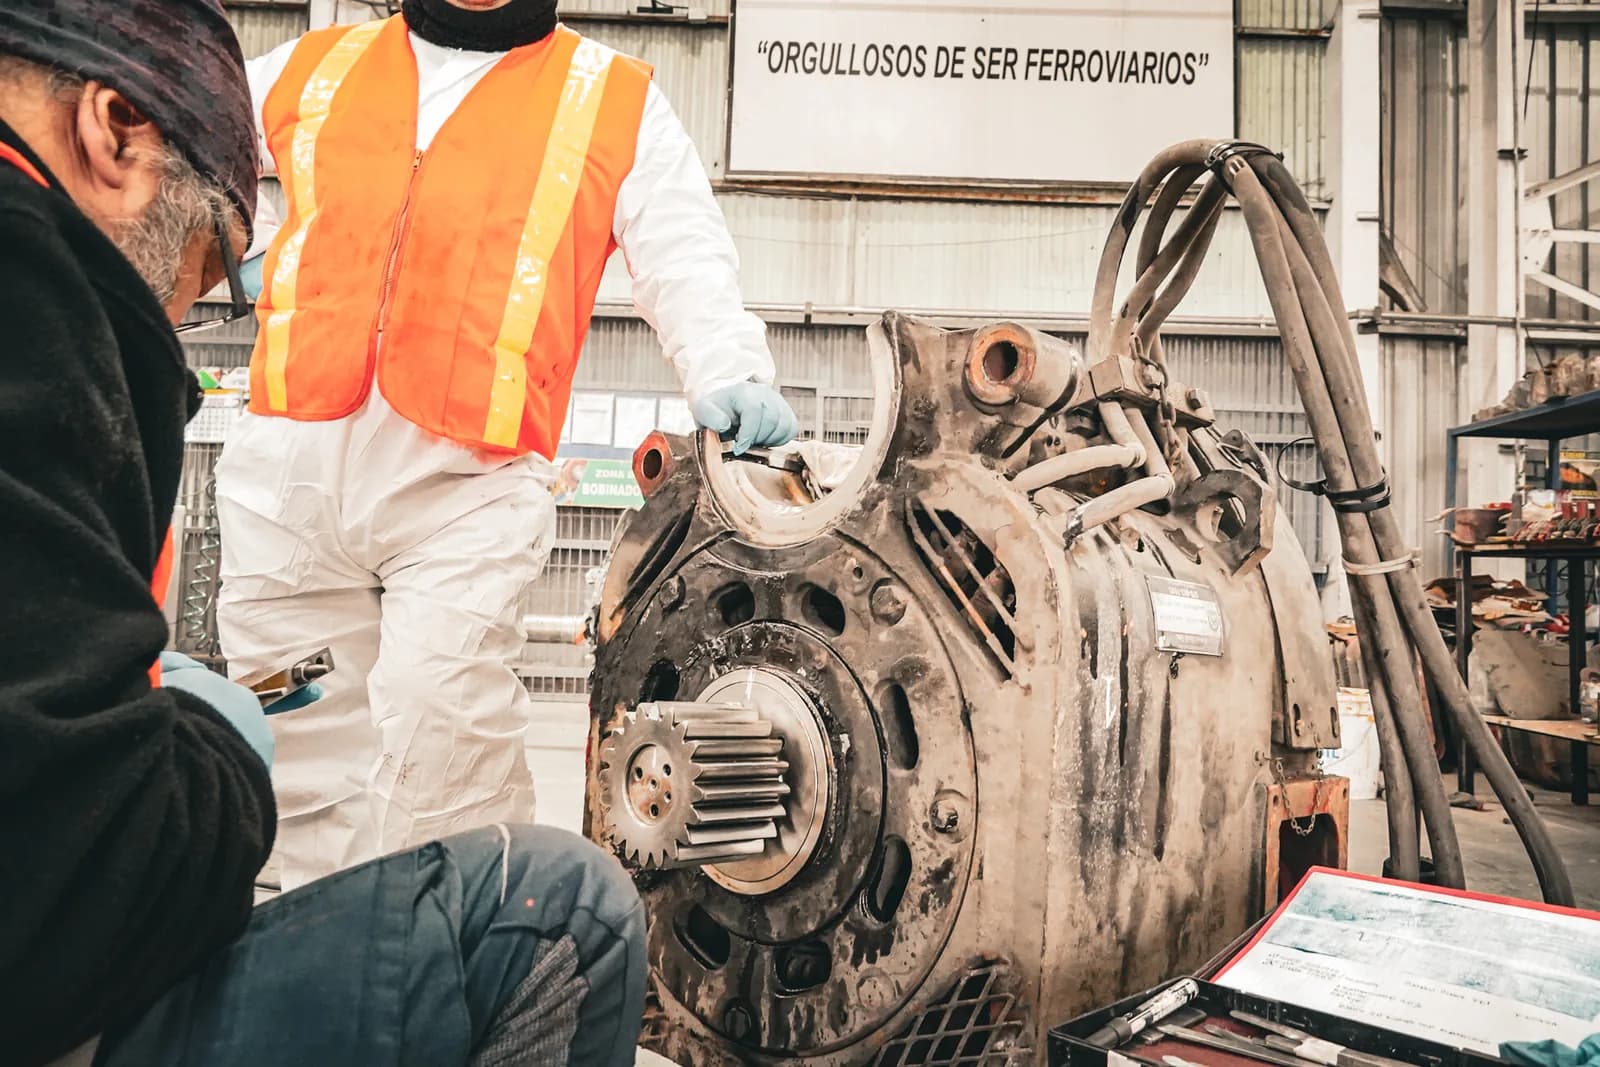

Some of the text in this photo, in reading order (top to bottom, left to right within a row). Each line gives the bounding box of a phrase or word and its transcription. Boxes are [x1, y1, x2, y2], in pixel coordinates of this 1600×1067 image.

[933, 45, 967, 78] DE
[971, 46, 1019, 80] SER
[594, 469, 625, 479] ZONA
[581, 482, 641, 497] BOBINADO
